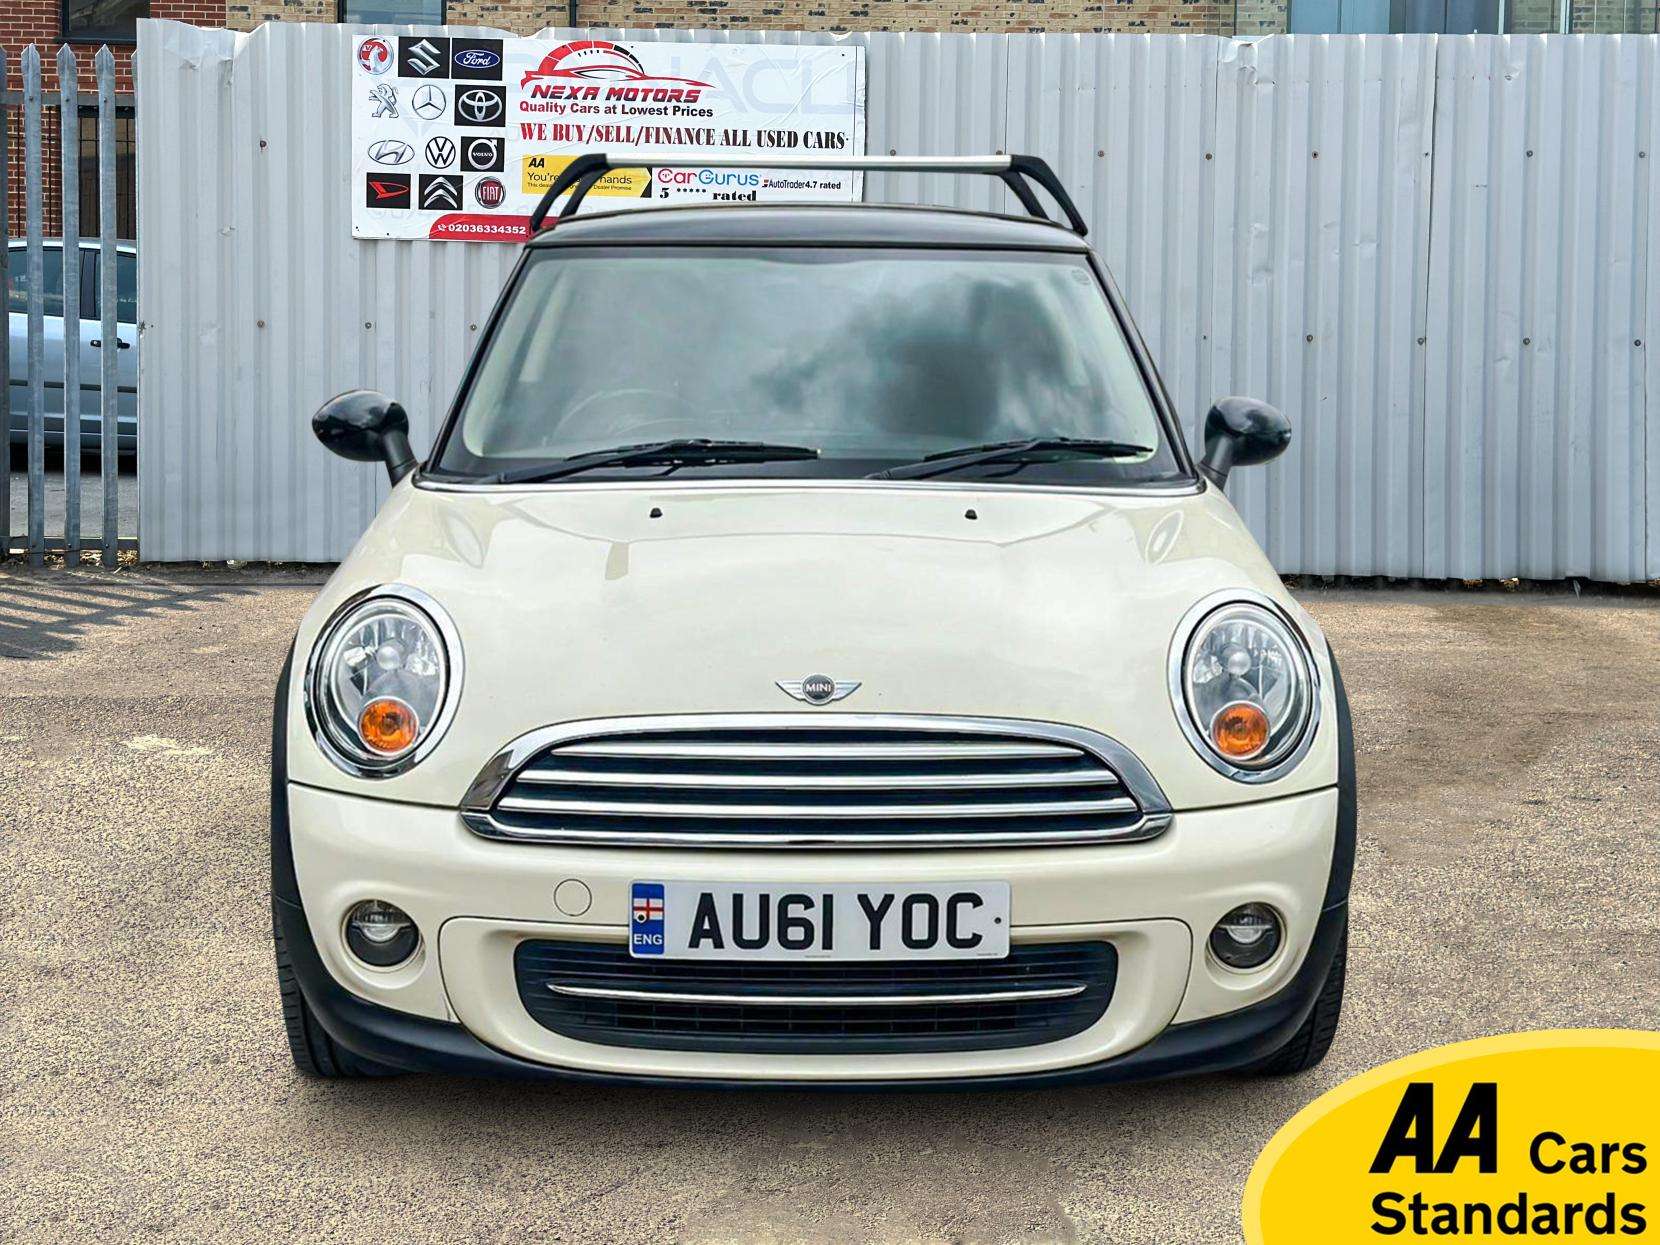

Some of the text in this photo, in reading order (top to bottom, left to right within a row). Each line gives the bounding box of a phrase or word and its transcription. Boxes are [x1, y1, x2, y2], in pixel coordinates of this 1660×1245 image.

[463, 52, 490, 66] Ford
[531, 84, 702, 103] NEXA MOTORS
[519, 101, 714, 117] Quality Cars at Lowest Prices
[520, 122, 845, 150] WE BUY/SELL/FINANCE ALL USED CARS
[528, 157, 545, 168] AA
[658, 168, 759, 186] CarGurus
[820, 181, 842, 190] rated
[482, 186, 499, 201] FIAT
[660, 187, 757, 201] 5 rated
[448, 224, 526, 235] 02036334352
[805, 683, 831, 692] MINI
[688, 892, 984, 951] AU61 YOC
[634, 934, 662, 946] ENG
